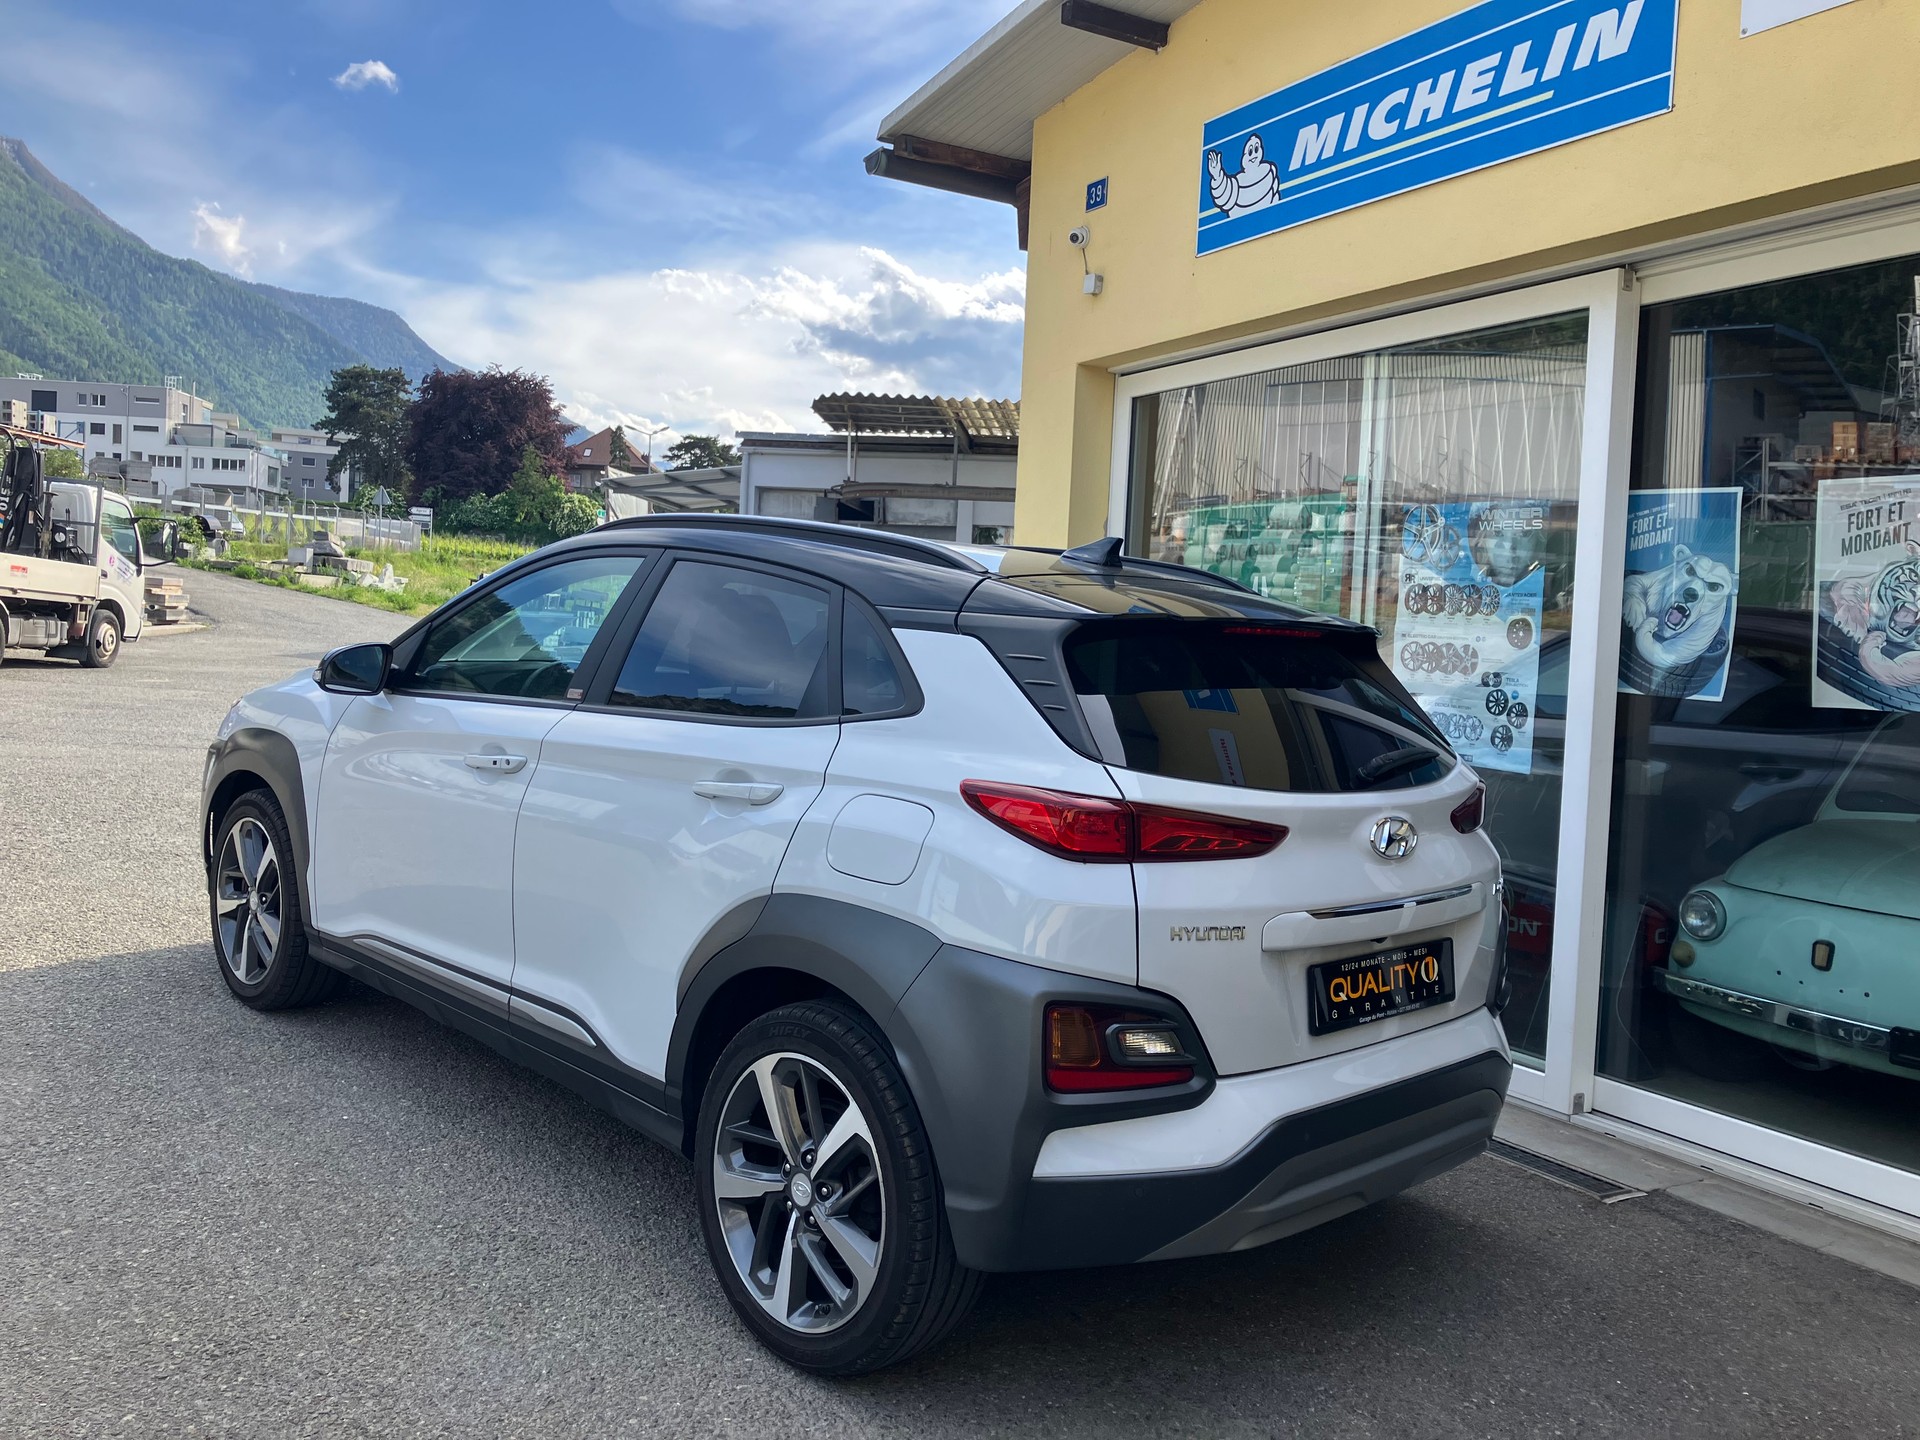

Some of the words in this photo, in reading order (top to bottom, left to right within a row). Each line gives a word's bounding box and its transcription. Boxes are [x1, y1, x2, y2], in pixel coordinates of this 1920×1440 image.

[1288, 0, 1645, 172] MICHELIN
[1090, 184, 1102, 205] 39
[1479, 519, 1543, 531] WHEELS
[1480, 507, 1543, 520] WINTER
[1632, 515, 1655, 535] FORT
[1656, 512, 1668, 528] ET
[1847, 505, 1883, 534] FORT
[1887, 500, 1906, 523] ET
[1630, 527, 1674, 552] MORDANT
[1841, 522, 1911, 557] MORDANT
[1170, 926, 1246, 941] HYUNDAI
[1341, 962, 1359, 972] 12/24
[1361, 957, 1385, 968] MONATE
[1392, 951, 1407, 961] MOIS
[1330, 961, 1419, 1003] QUALITY
[1332, 985, 1440, 1019] GARANTIE
[1359, 1014, 1372, 1023] Garage
